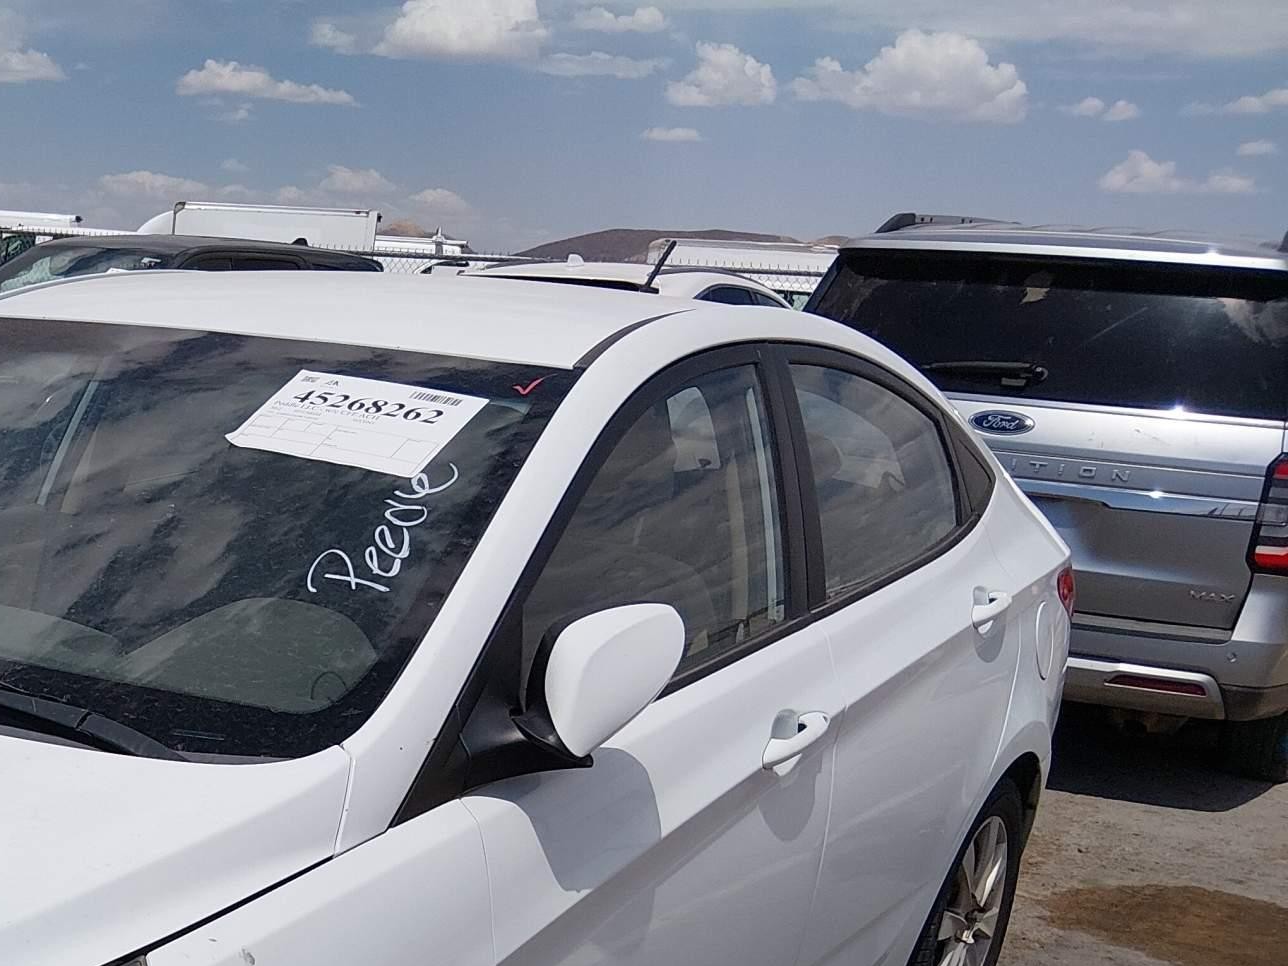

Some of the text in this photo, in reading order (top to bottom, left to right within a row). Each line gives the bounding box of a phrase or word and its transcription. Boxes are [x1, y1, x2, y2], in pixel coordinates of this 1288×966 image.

[293, 390, 445, 425] 45268262
[982, 414, 1018, 431] Ford
[1011, 458, 1131, 483] ITION
[1189, 590, 1236, 602] MAX
